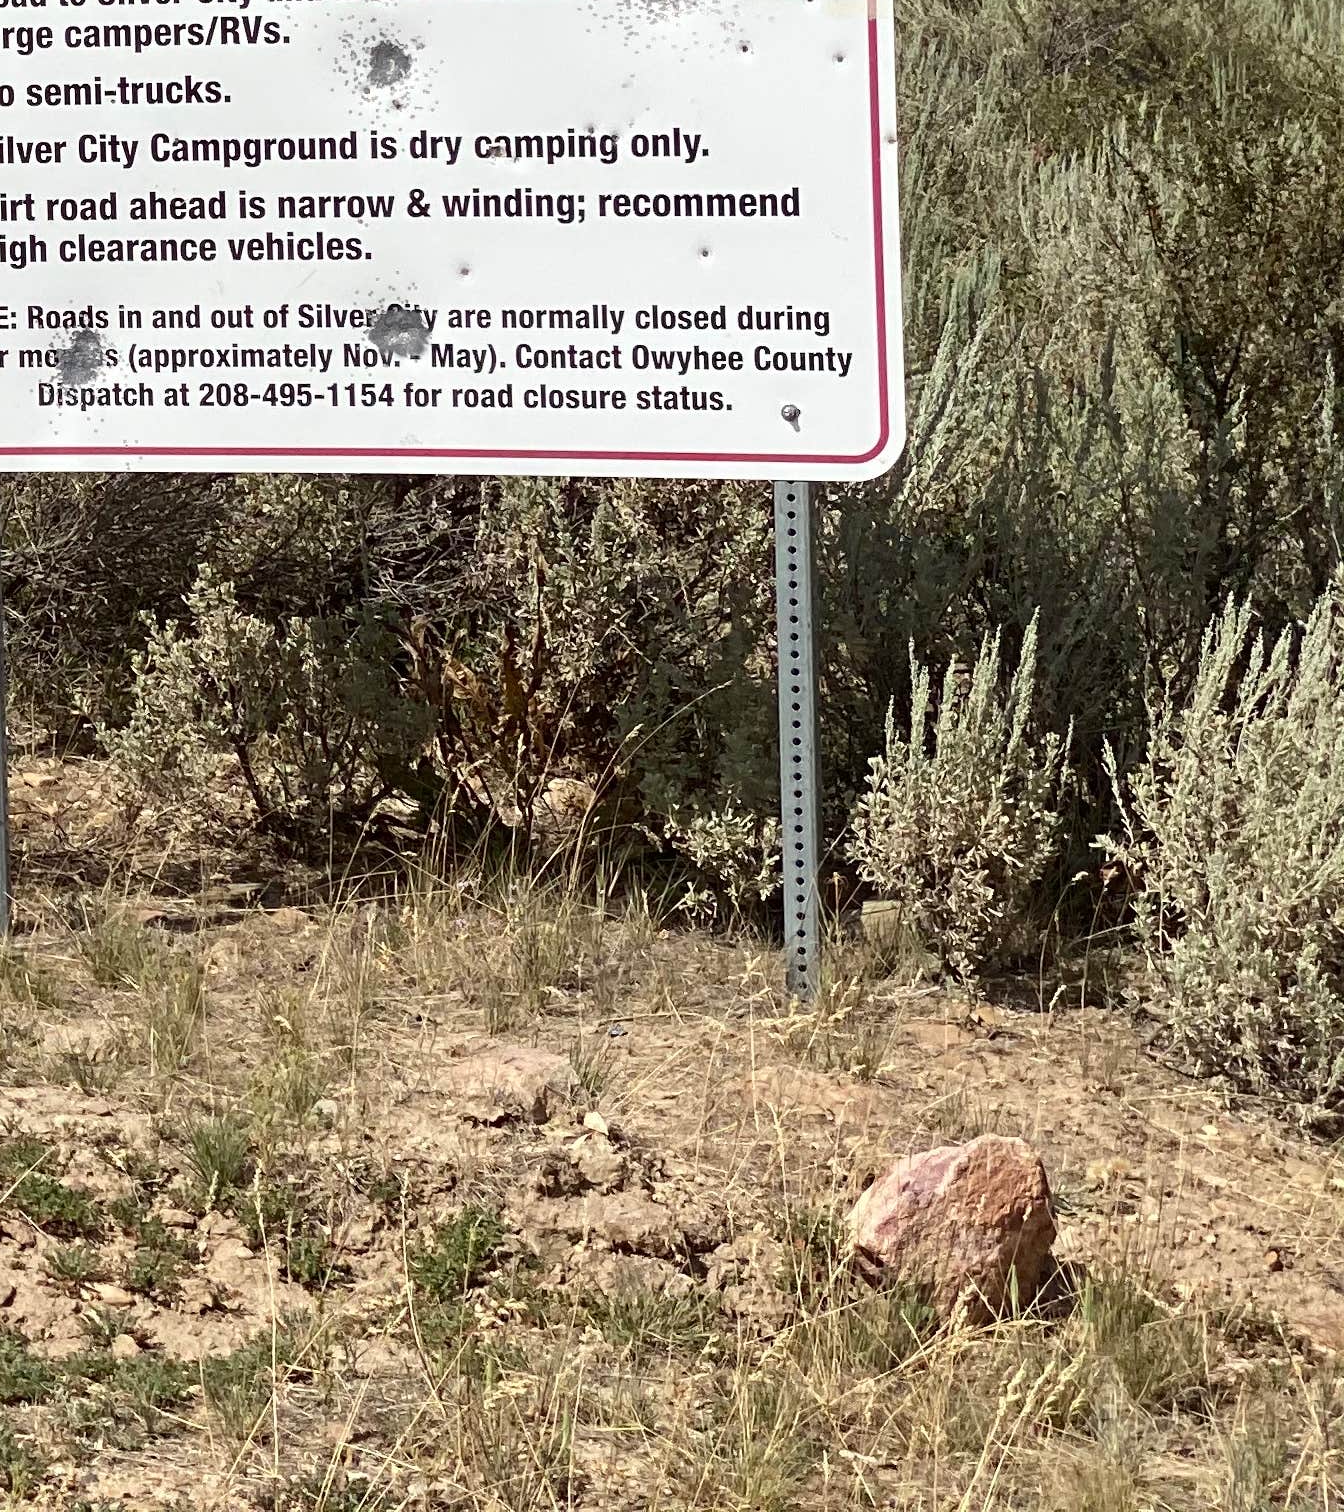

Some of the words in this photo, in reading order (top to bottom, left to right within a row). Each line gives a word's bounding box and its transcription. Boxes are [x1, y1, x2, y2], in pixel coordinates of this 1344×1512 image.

[64, 15, 290, 53] campers/RVs.
[26, 75, 231, 107] semi-trucks.
[78, 134, 139, 169] City
[150, 130, 358, 168] Campground
[370, 130, 397, 160] is
[409, 129, 463, 166] dry
[474, 127, 618, 165] camping
[631, 127, 709, 164] only.
[46, 191, 117, 221] road
[129, 190, 227, 220] ahead
[239, 190, 266, 219] is
[278, 195, 395, 219] narrow
[407, 188, 431, 218] &
[441, 187, 585, 224] winding;
[598, 187, 800, 217] recommend
[59, 233, 217, 263] clearance
[227, 231, 372, 261] vehicles.
[27, 305, 109, 330] Roads
[118, 304, 142, 329] in
[152, 304, 201, 329] and
[210, 304, 254, 329] out
[263, 303, 289, 329] of
[298, 303, 377, 329] Silver
[448, 309, 492, 329] are
[501, 304, 625, 335] normally
[635, 304, 727, 330] closed
[737, 305, 830, 337] during
[18, 347, 118, 368] mos
[128, 343, 333, 374] (approximately
[343, 343, 400, 368] Nov.
[431, 343, 506, 374] May).
[515, 344, 622, 369] Contact
[632, 344, 744, 376] Owyhee
[754, 345, 853, 378] County
[38, 381, 154, 412] Dispatch
[164, 383, 190, 407] at
[199, 383, 395, 407] 208-495-1154
[403, 382, 442, 408] for
[452, 383, 513, 408] road
[523, 383, 627, 410] closure
[636, 385, 733, 411] status.
